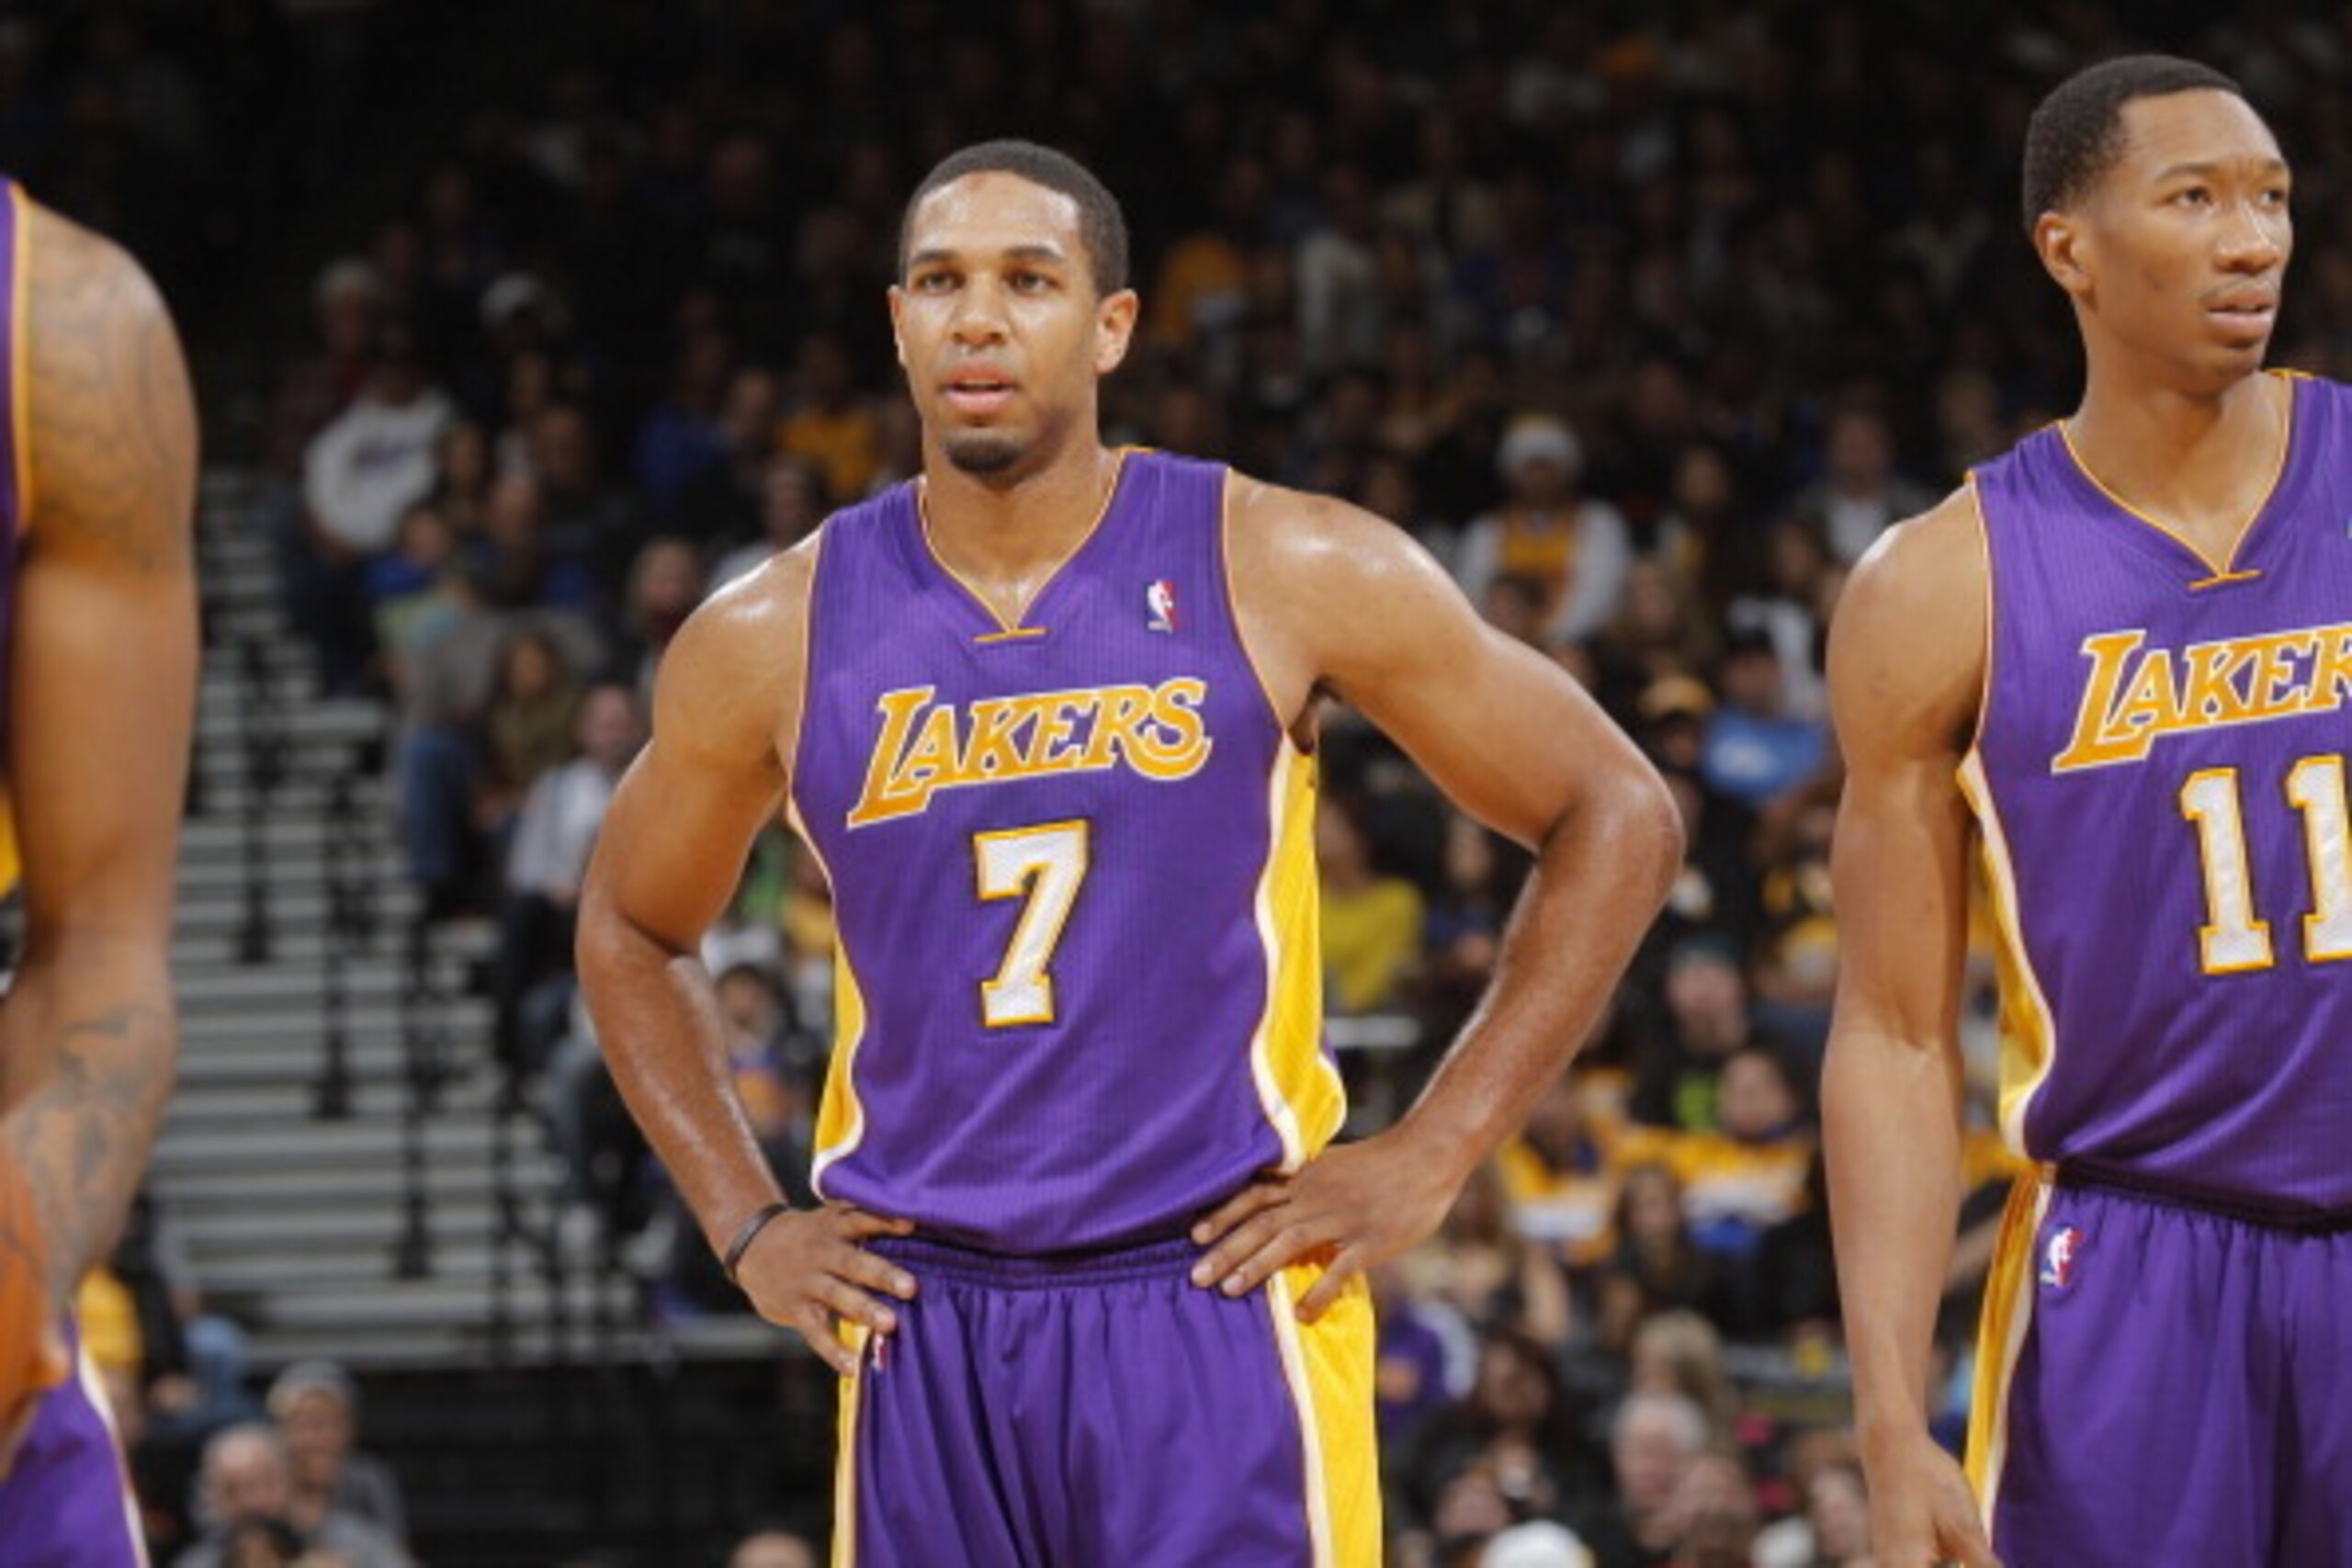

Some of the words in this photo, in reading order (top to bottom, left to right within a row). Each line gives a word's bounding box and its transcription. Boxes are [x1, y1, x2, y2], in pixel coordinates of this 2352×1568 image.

[847, 677, 1213, 830] LAKERS
[973, 818, 1090, 1028] 7
[2178, 753, 2352, 976] 11
